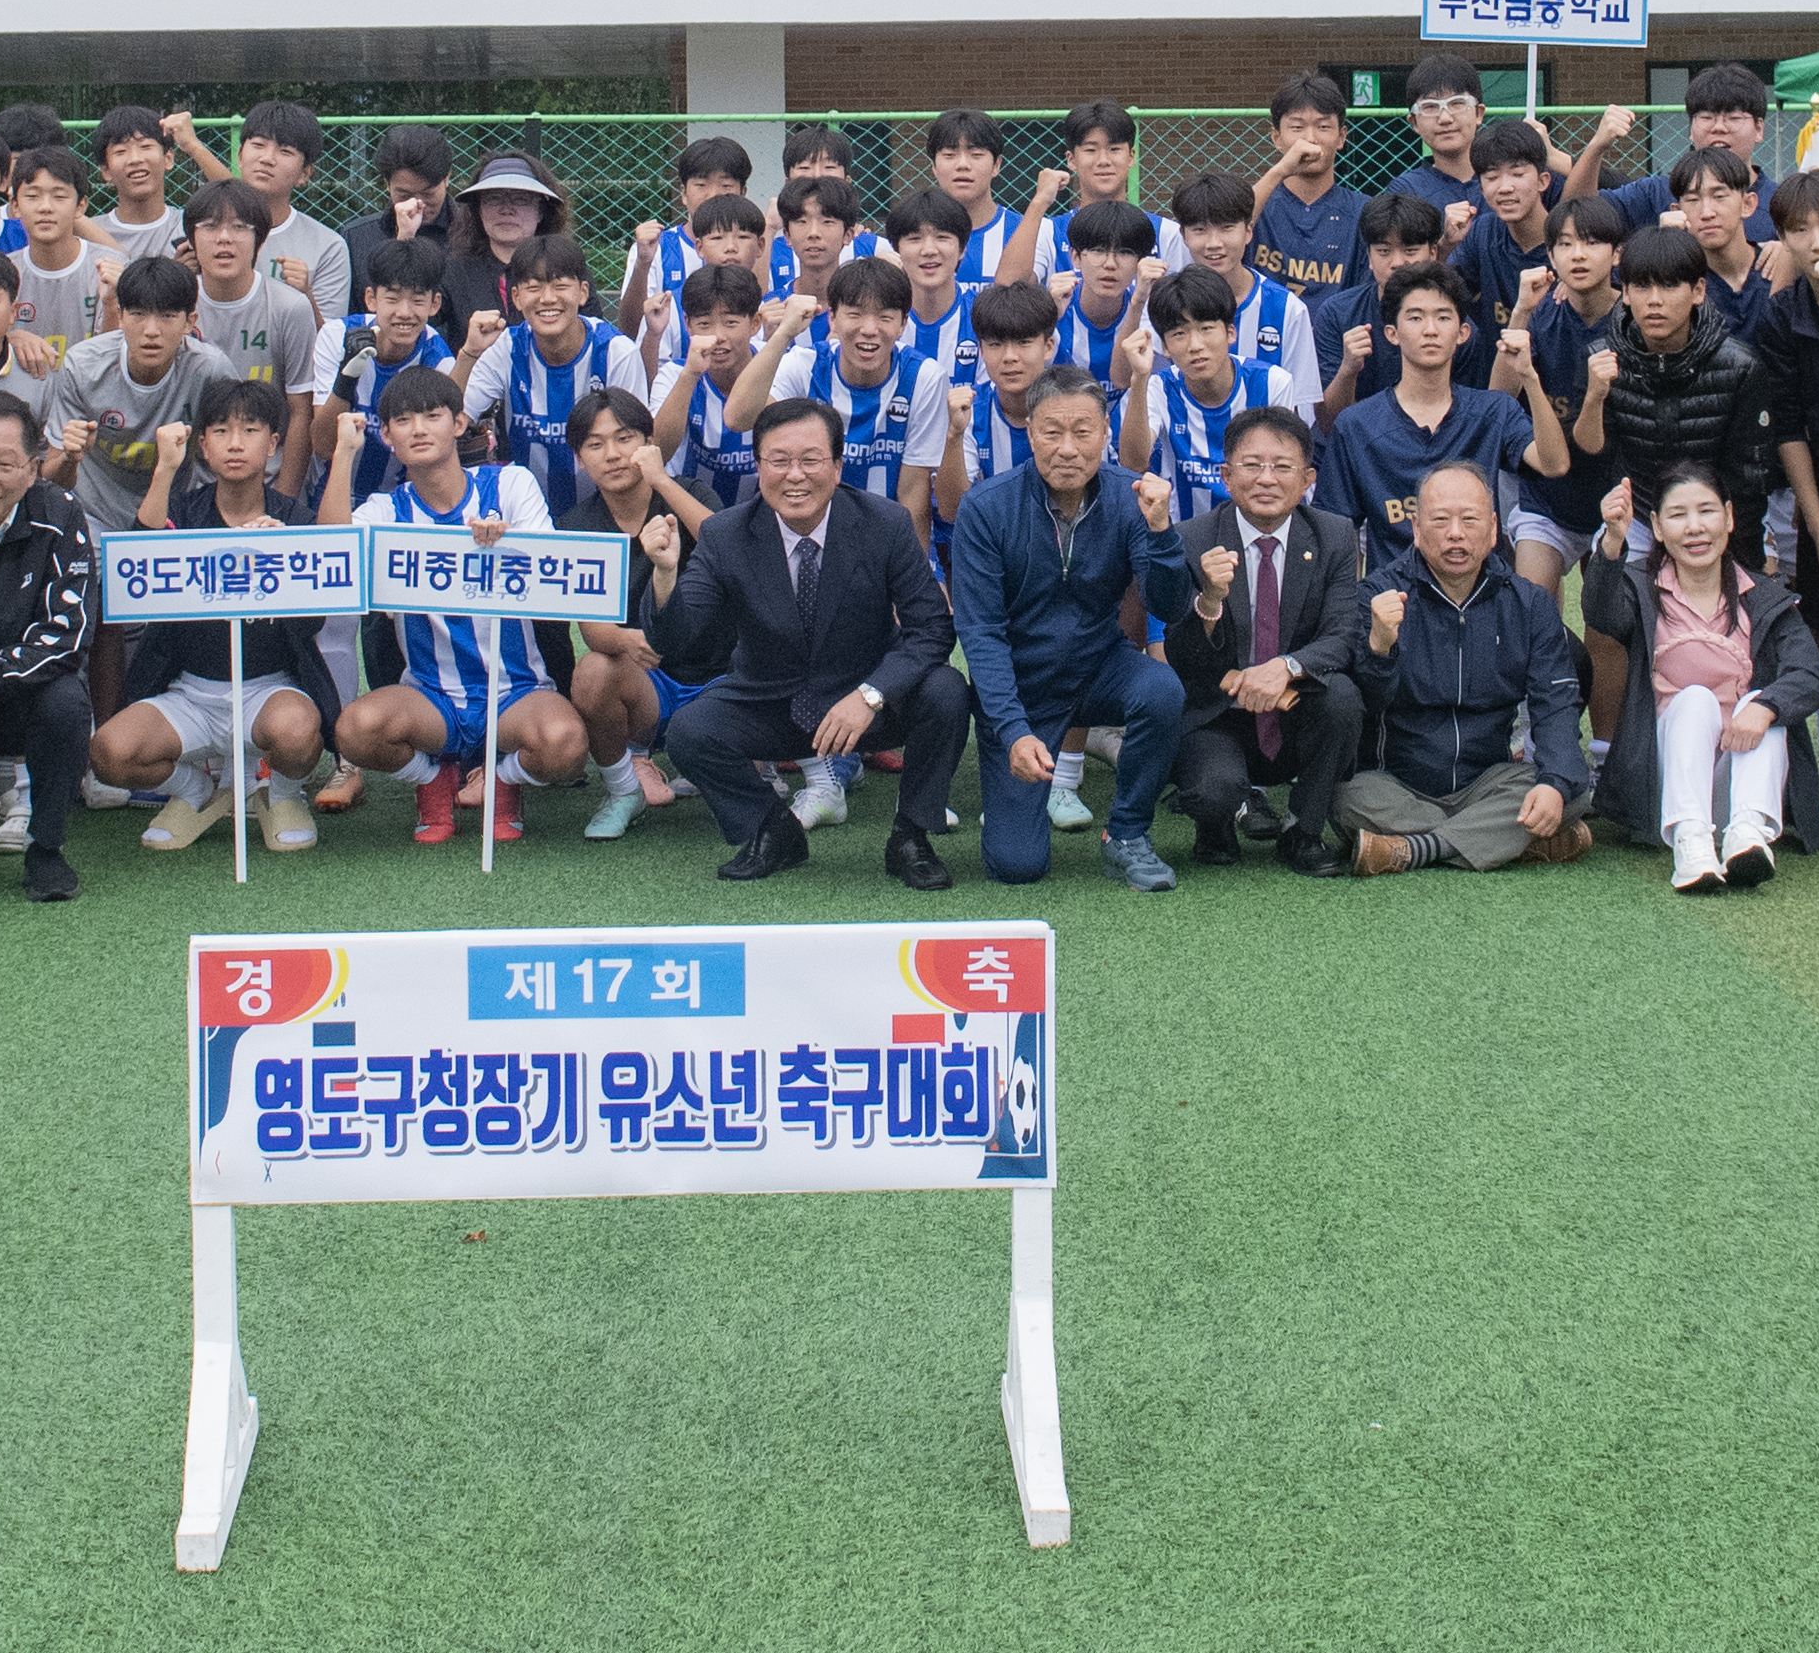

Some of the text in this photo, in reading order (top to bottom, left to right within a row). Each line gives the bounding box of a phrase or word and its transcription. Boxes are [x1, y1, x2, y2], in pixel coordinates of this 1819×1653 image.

[1254, 244, 1343, 285] BS.NAM
[240, 329, 267, 350] 14
[117, 551, 354, 599] 영도제일중학교
[389, 548, 607, 596] 태종대중학교
[225, 959, 272, 1017] 경
[571, 957, 634, 1005] 17
[962, 945, 1015, 1004] 축
[254, 1042, 995, 1155] 영도구청장기 유소년 축구대회
